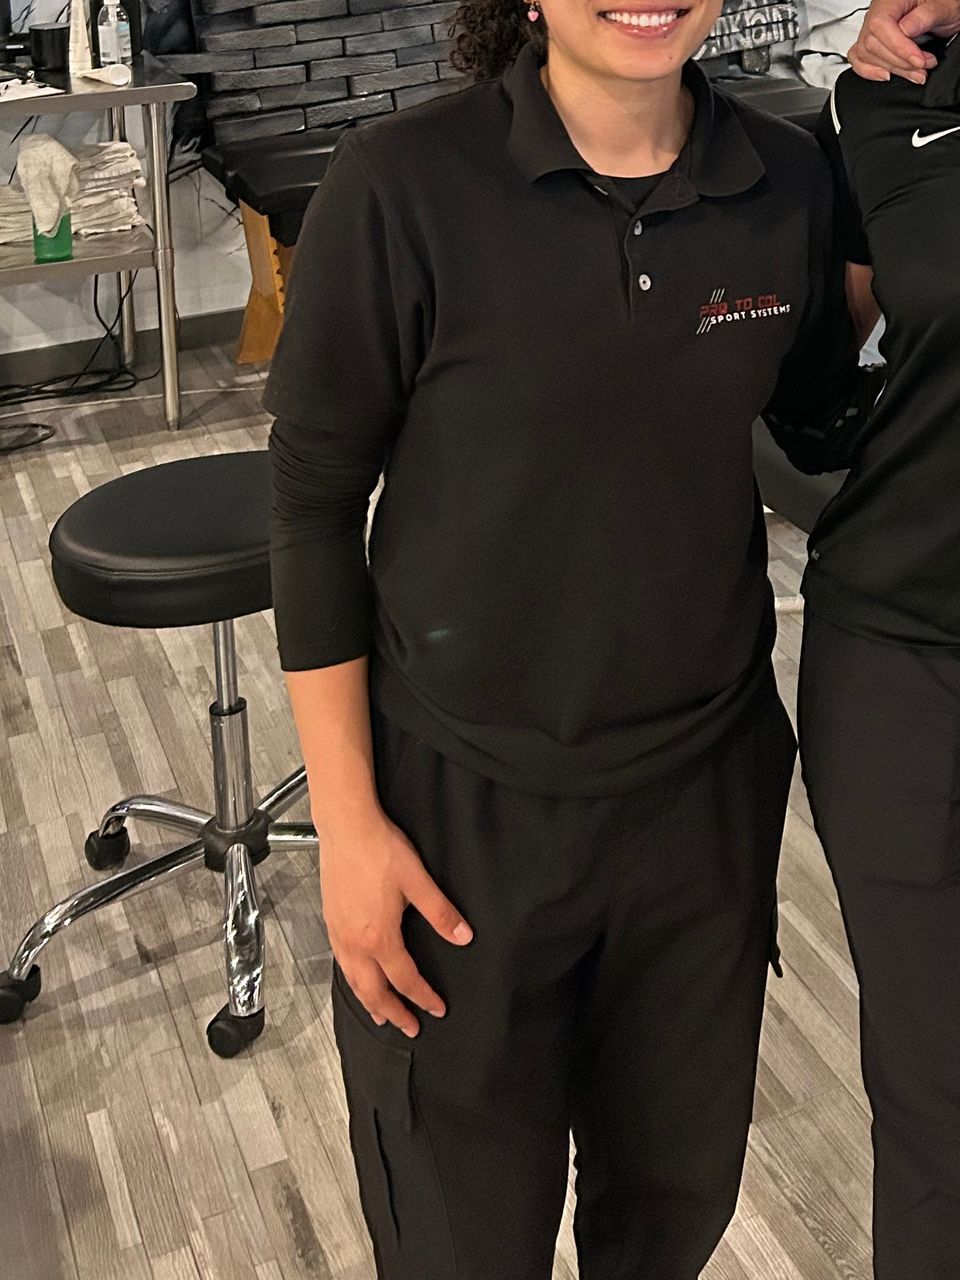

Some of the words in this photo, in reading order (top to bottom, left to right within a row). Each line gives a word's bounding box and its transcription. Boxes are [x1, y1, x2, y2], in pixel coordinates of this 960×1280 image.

[735, 297, 753, 312] TO
[710, 311, 746, 325] SPORT
[750, 304, 791, 318] SYSTEMS
